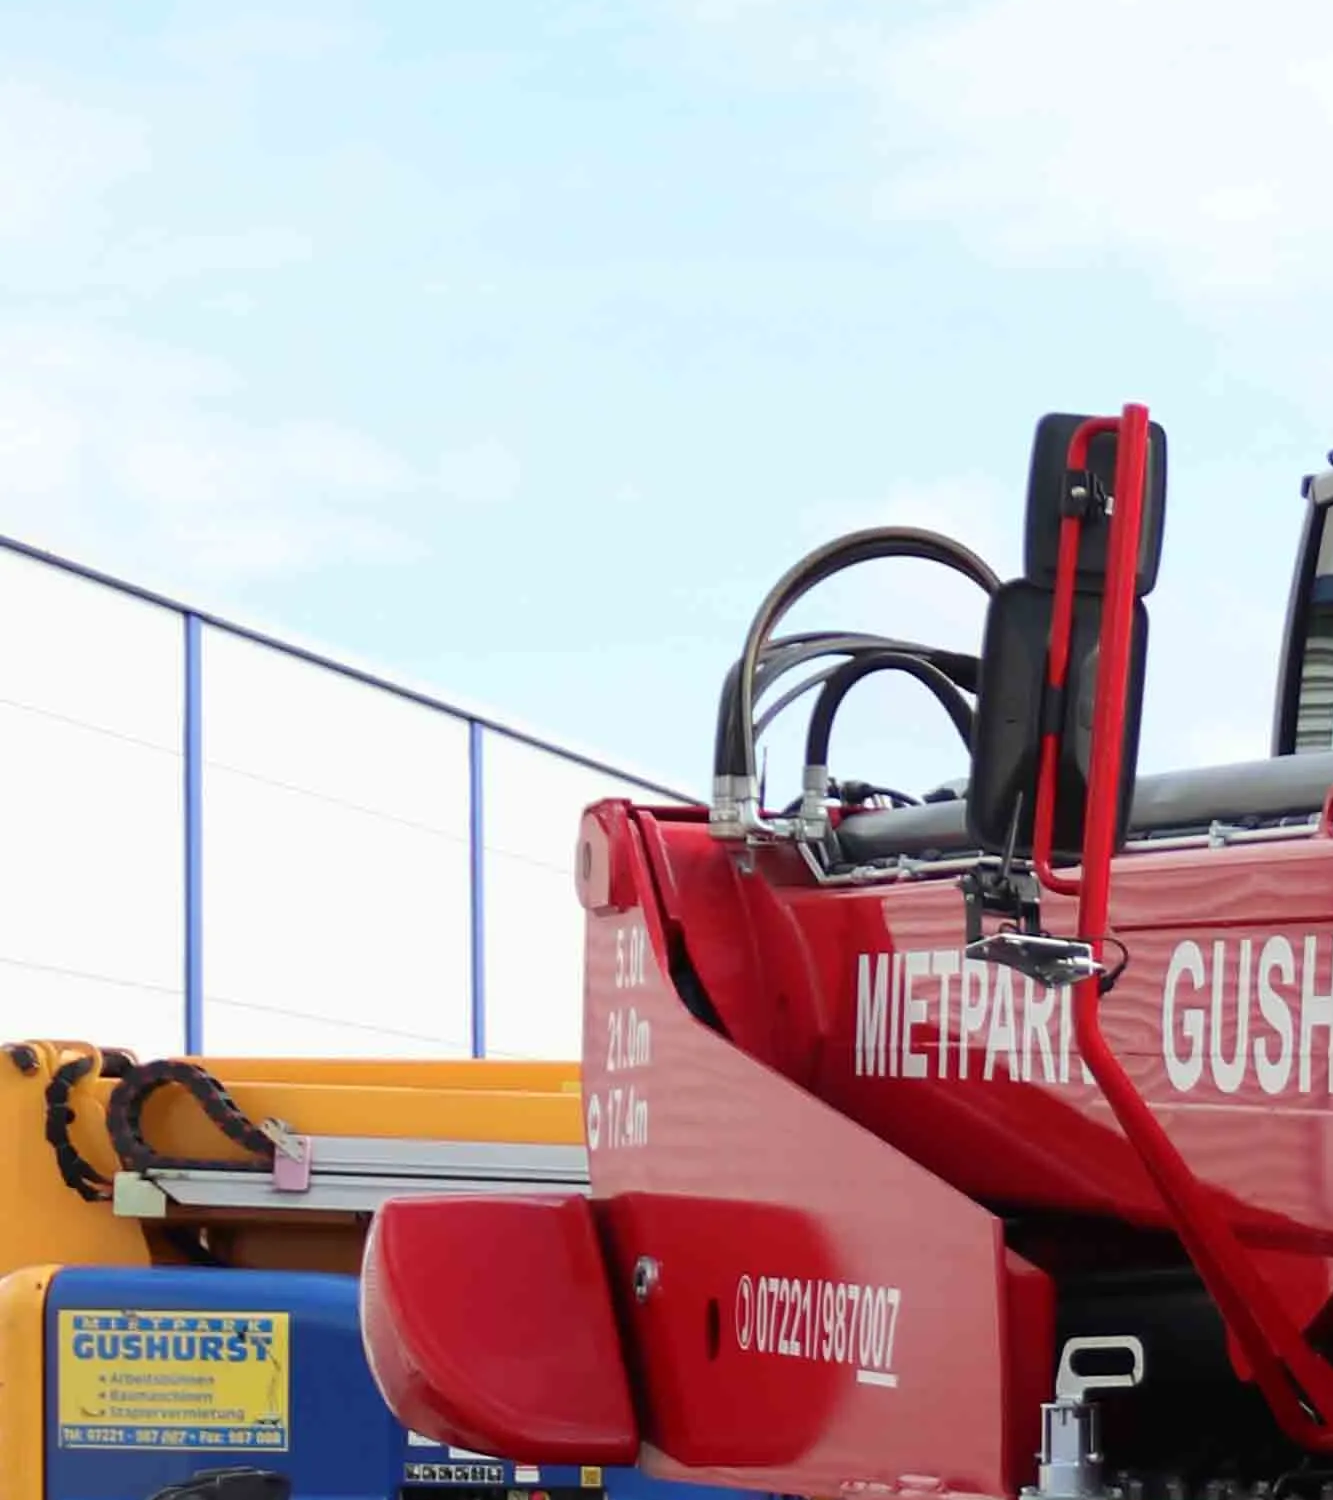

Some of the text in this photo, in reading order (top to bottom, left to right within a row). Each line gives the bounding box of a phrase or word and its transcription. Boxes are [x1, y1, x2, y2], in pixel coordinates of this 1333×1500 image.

[607, 1007, 650, 1072] 21.0m
[73, 1333, 272, 1362] GUSHURST
[756, 1275, 902, 1370] 07221/987007
